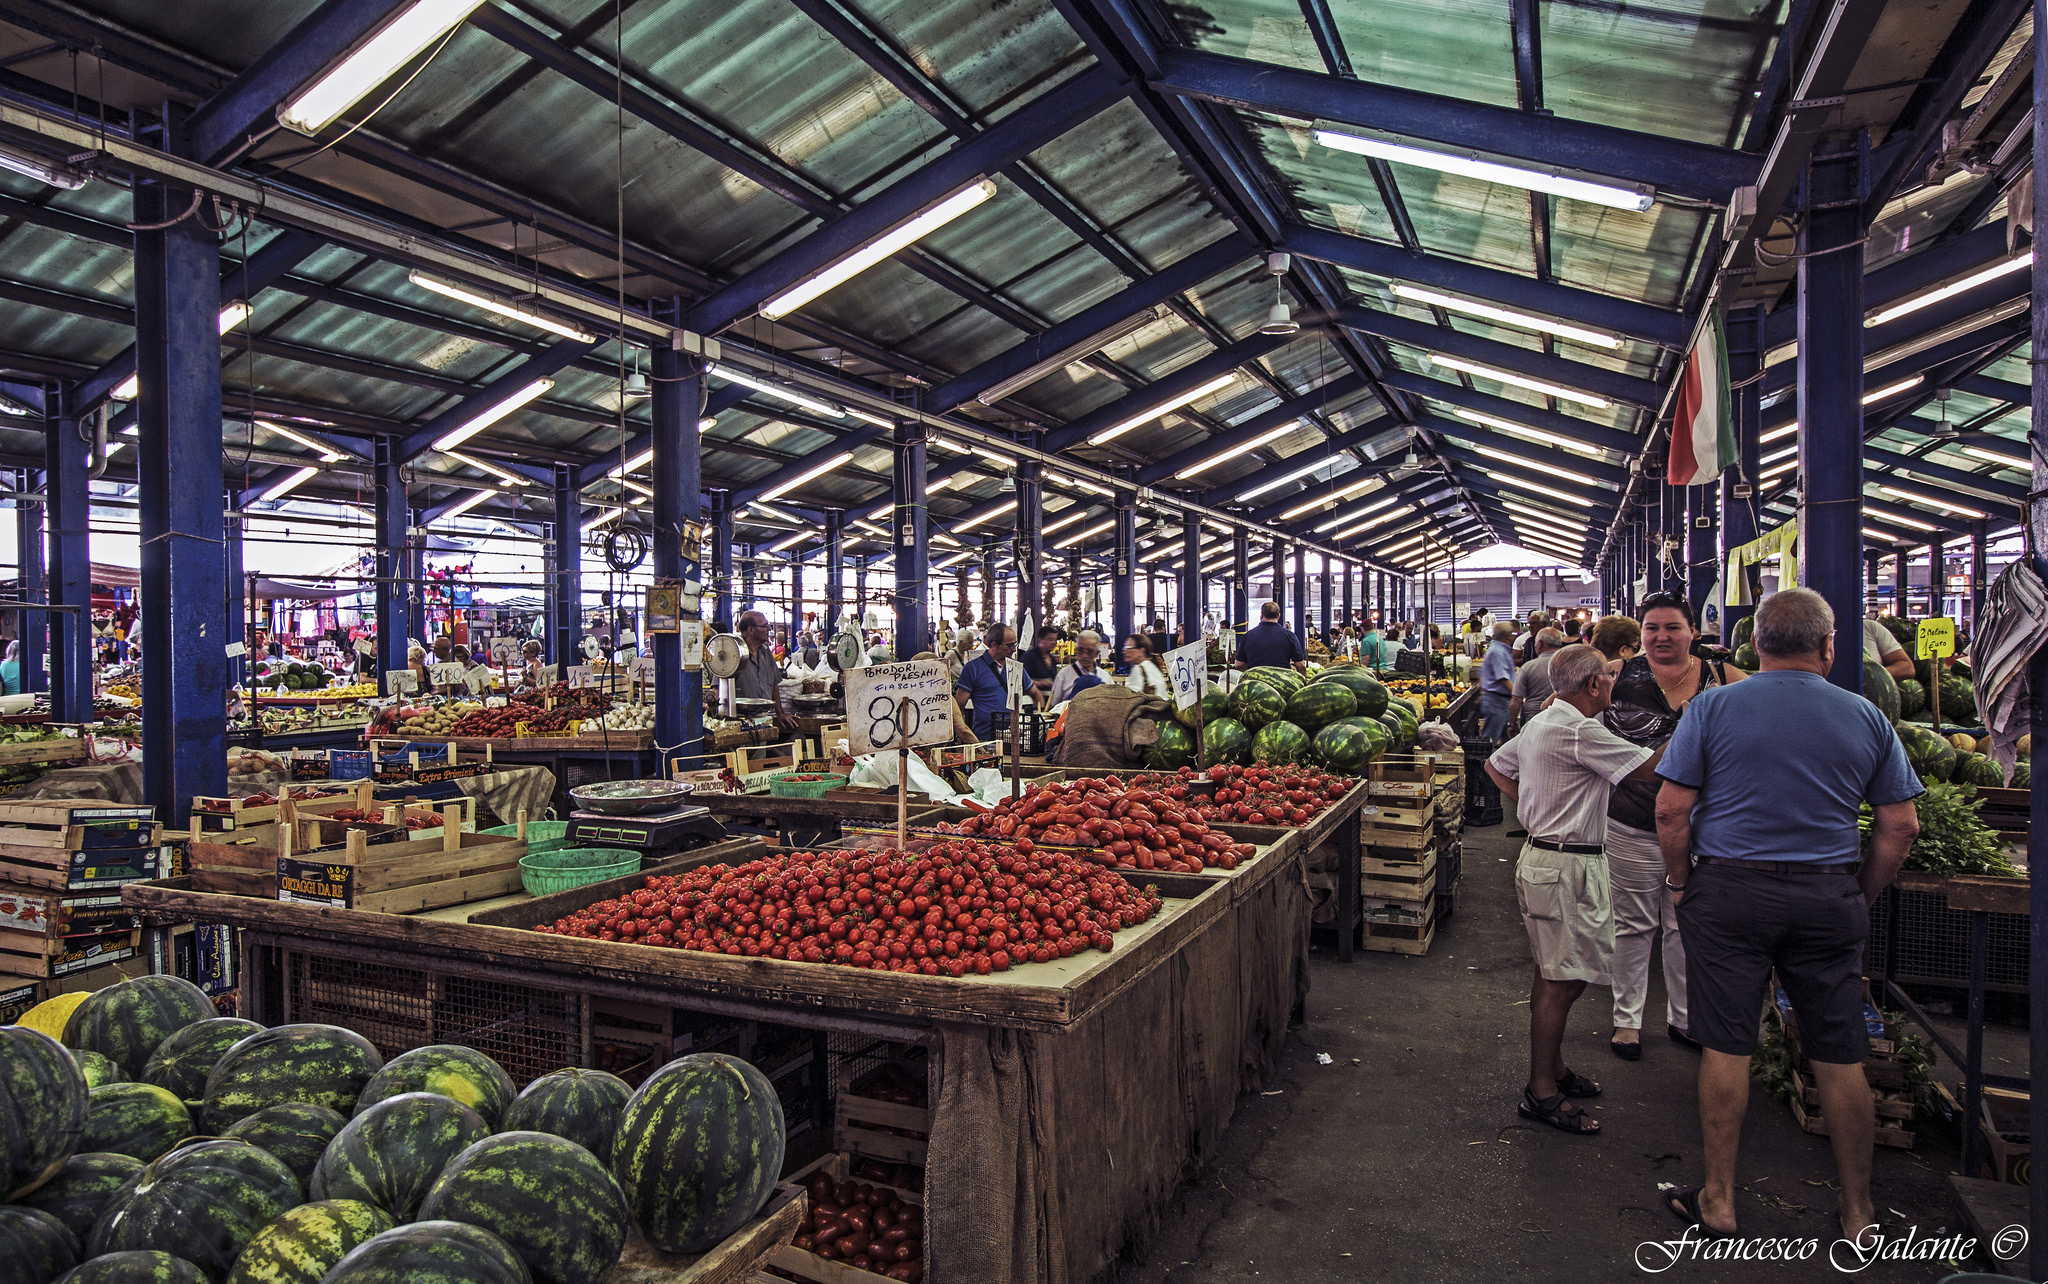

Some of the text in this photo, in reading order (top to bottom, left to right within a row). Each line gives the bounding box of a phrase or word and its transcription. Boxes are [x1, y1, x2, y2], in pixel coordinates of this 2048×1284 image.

[1920, 628, 1926, 638] 2
[1922, 638, 1928, 656] 1
[864, 663, 916, 679] POMODORI
[874, 678, 947, 692] FIASCHETTO
[869, 696, 920, 748] 80
[418, 772, 442, 784] Extra
[281, 876, 316, 894] ORTAGGI
[317, 882, 331, 896] DA
[332, 884, 343, 898] RE
